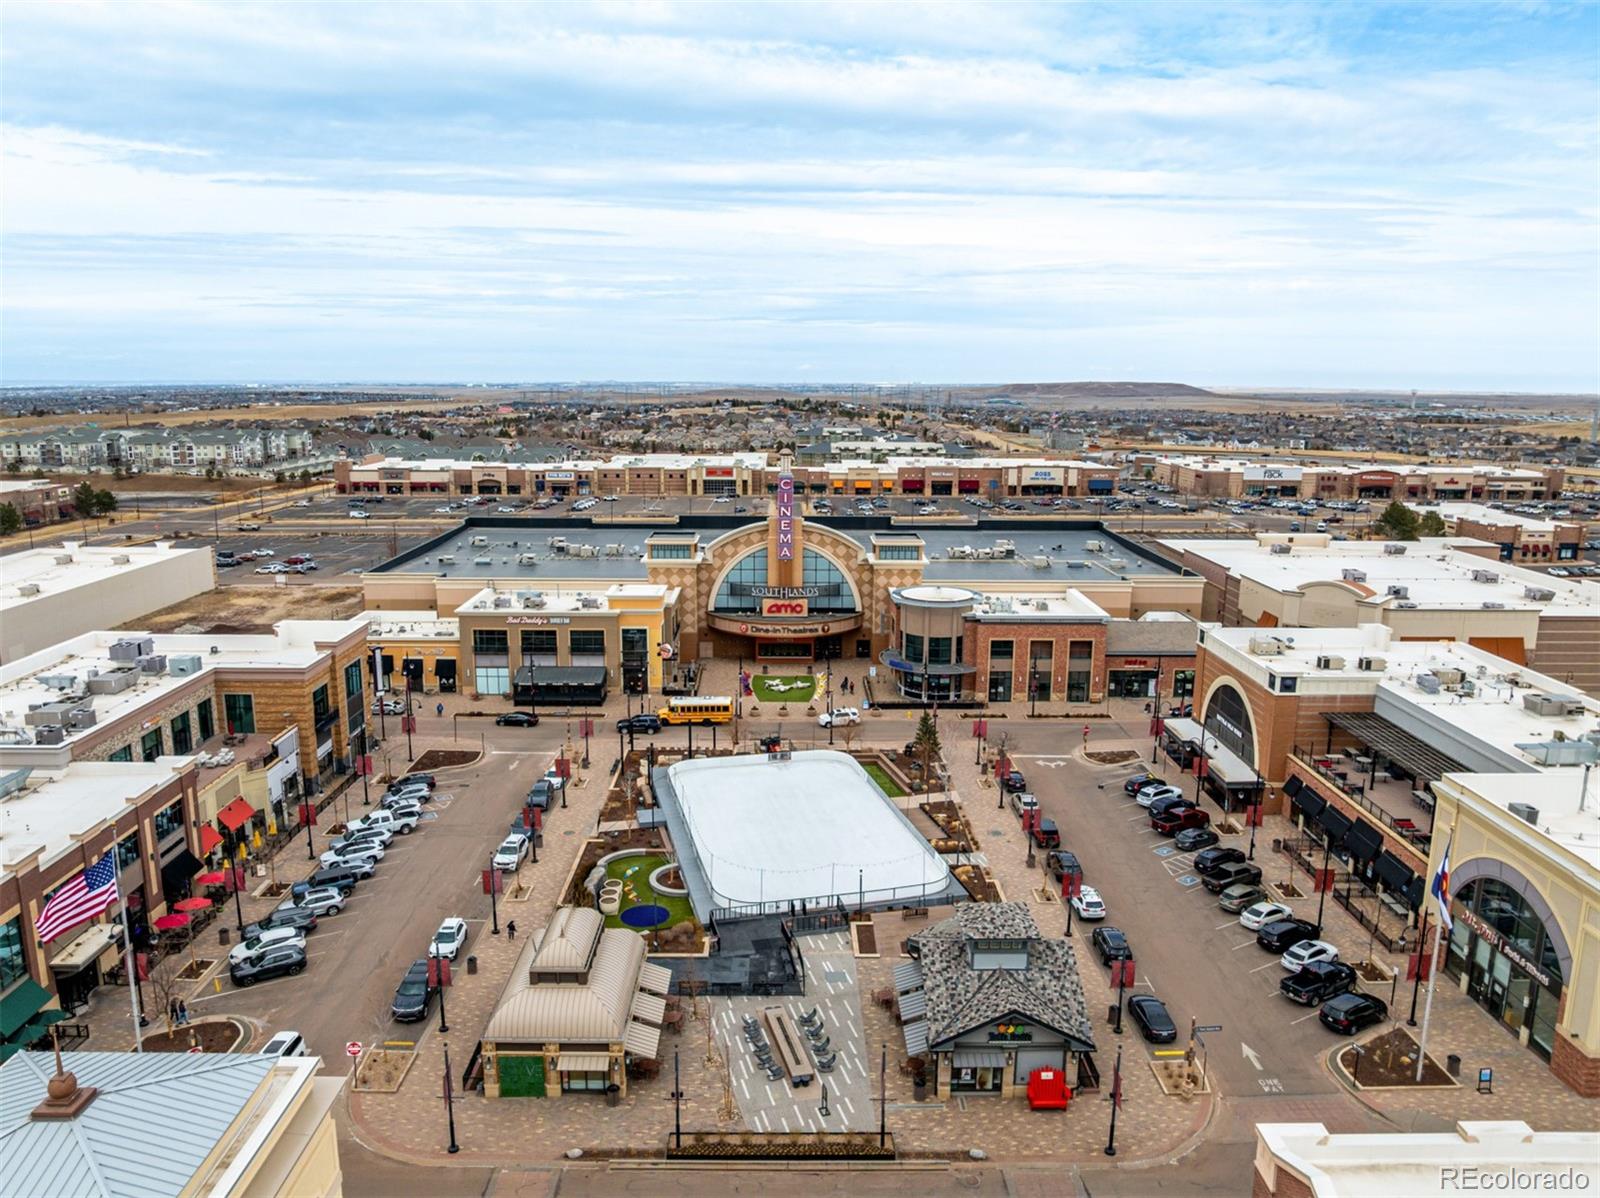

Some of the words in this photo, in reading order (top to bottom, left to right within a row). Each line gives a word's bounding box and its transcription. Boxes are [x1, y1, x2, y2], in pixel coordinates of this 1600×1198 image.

[779, 479, 792, 557] CINEMA
[751, 587, 819, 599] SOUTHLANDS
[782, 626, 819, 635] Theatres
